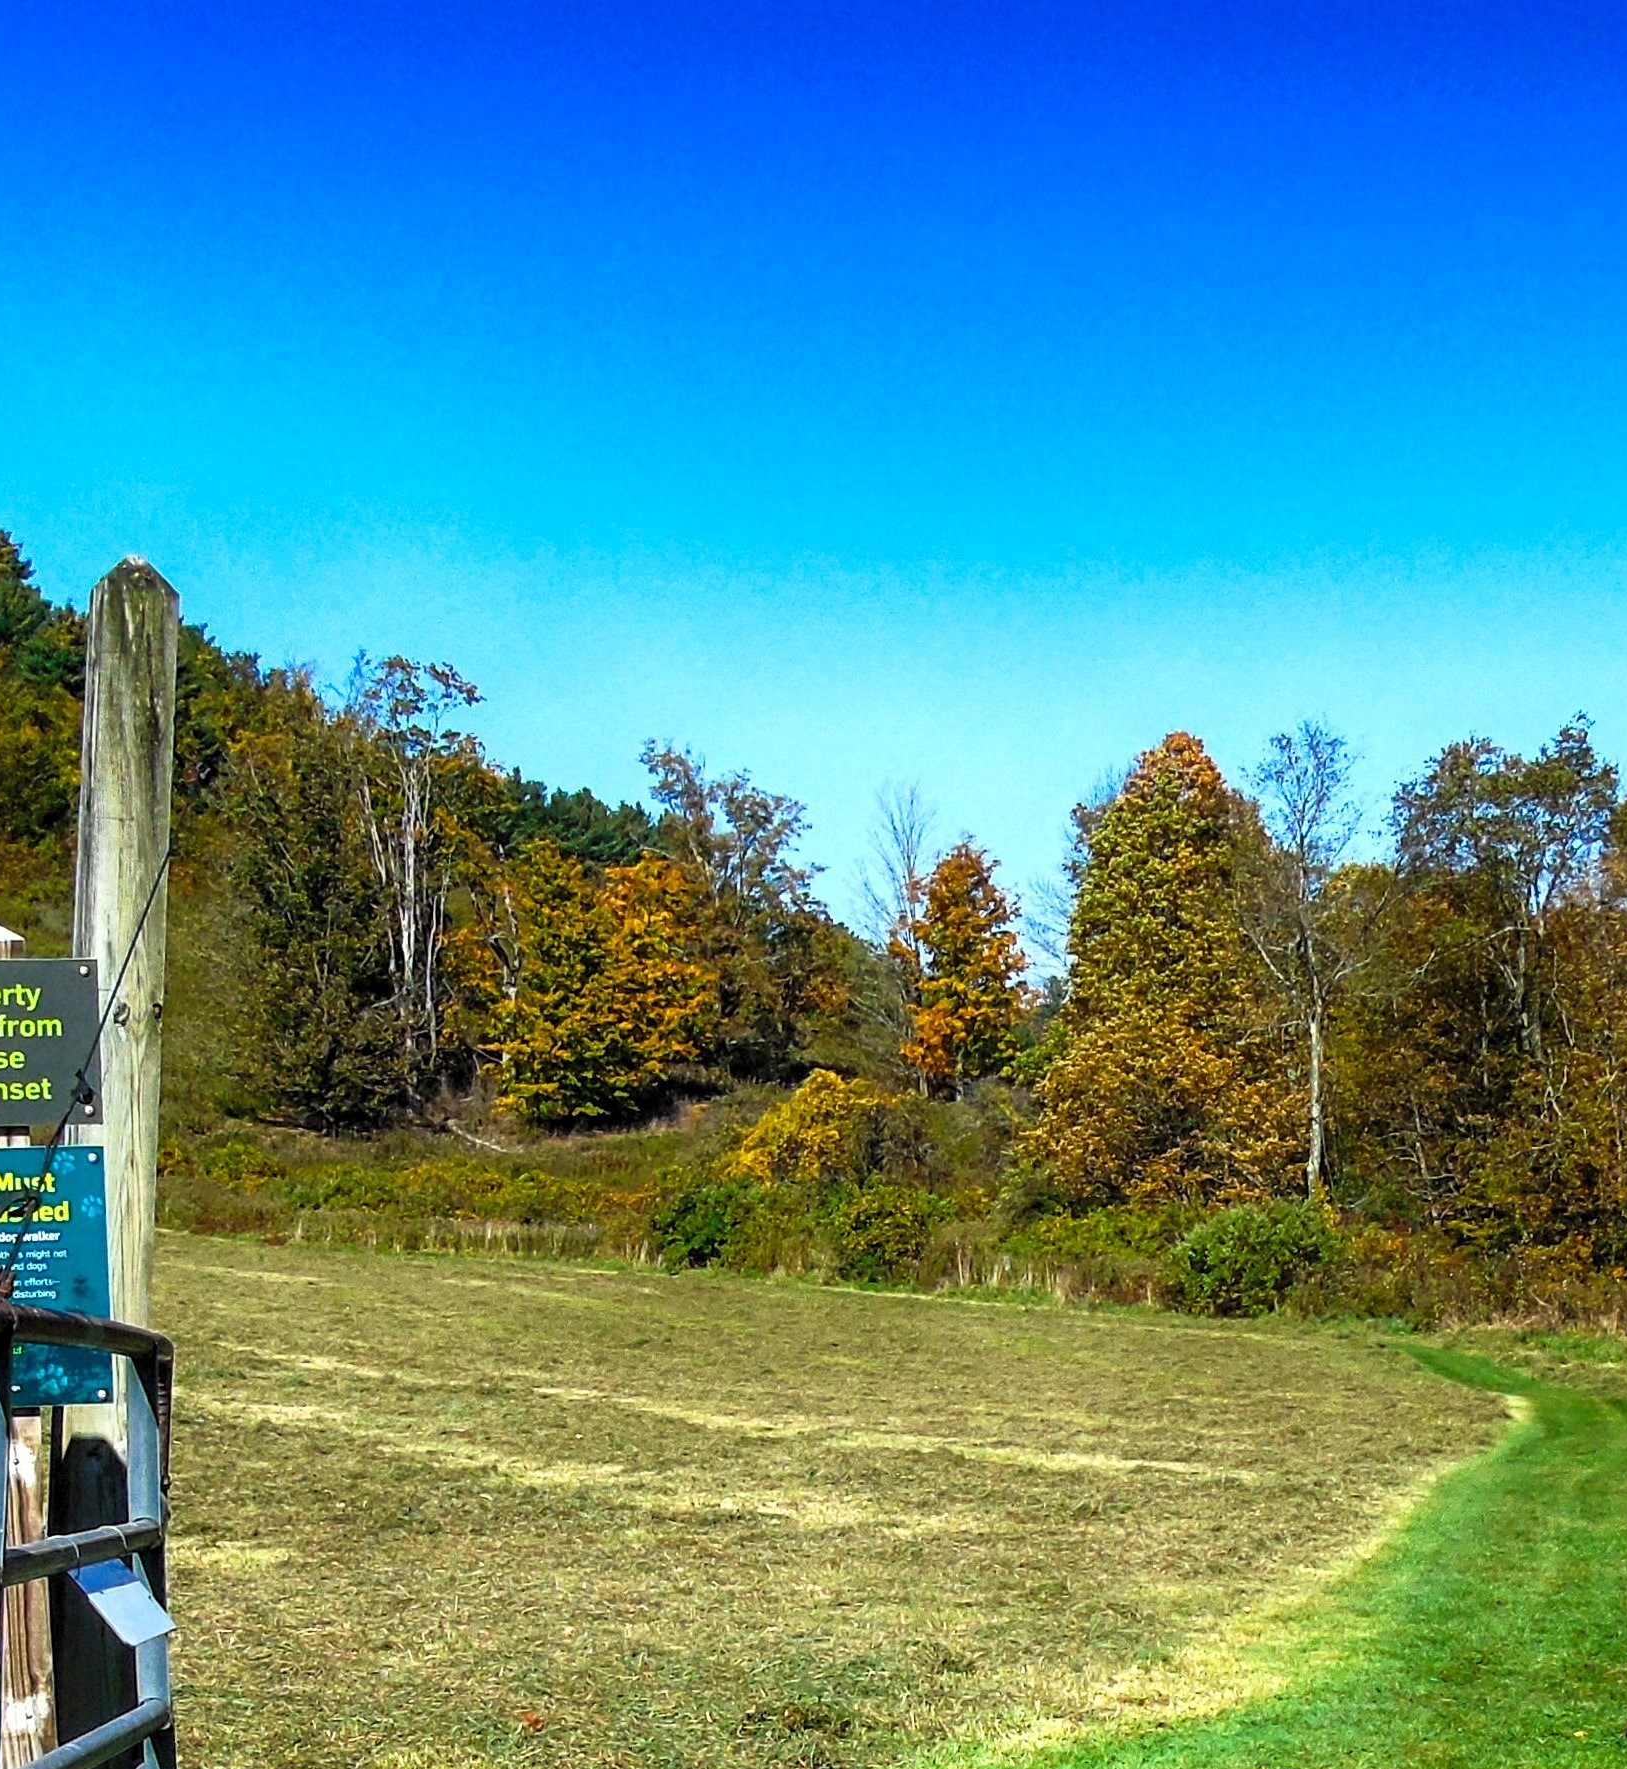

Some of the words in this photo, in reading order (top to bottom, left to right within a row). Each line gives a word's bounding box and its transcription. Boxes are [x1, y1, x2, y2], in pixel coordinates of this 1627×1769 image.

[22, 1230, 60, 1241] walker
[25, 1249, 50, 1259] might
[52, 1249, 67, 1257] not
[26, 1262, 47, 1272] dogs
[12, 1290, 56, 1299] disturbing
